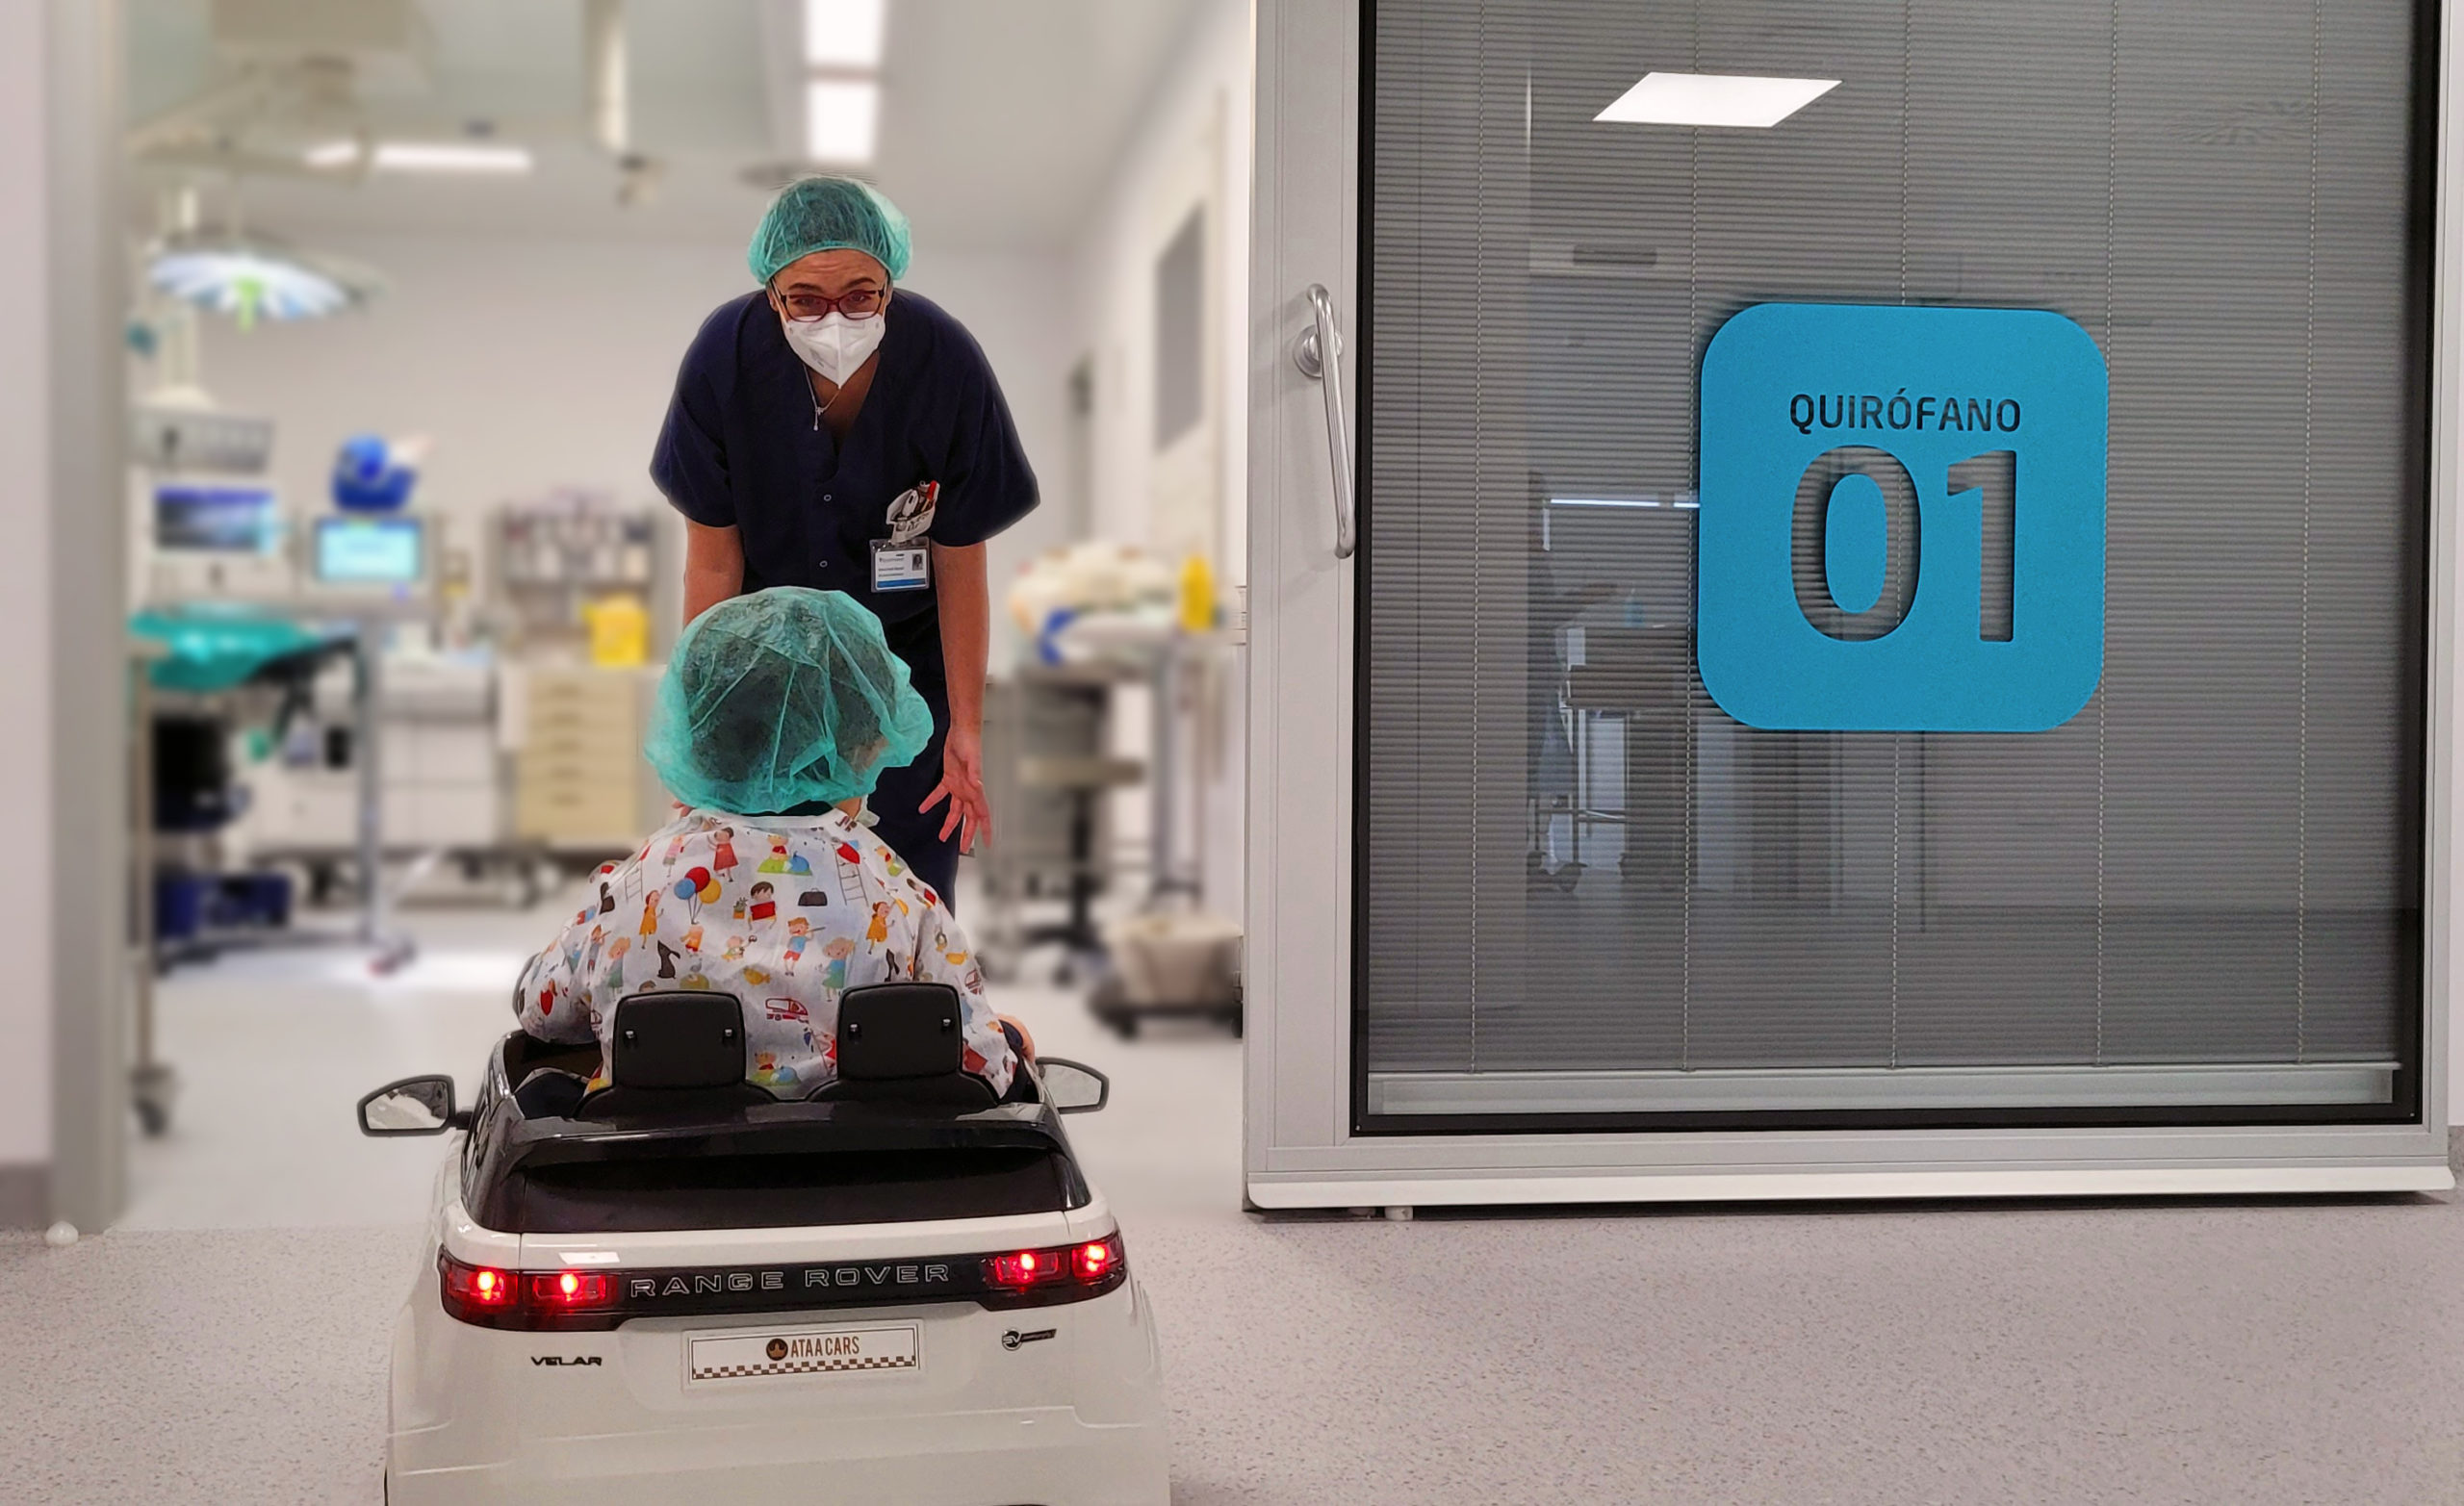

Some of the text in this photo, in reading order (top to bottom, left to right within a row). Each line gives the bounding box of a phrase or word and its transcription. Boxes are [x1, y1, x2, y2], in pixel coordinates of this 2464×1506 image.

[1789, 387, 2021, 435] QUIRÓFANO
[1790, 445, 2017, 642] 01
[630, 1264, 949, 1298] RANGE ROVER
[530, 1355, 603, 1367] VELAR
[790, 1335, 860, 1359] ATAA CARS
